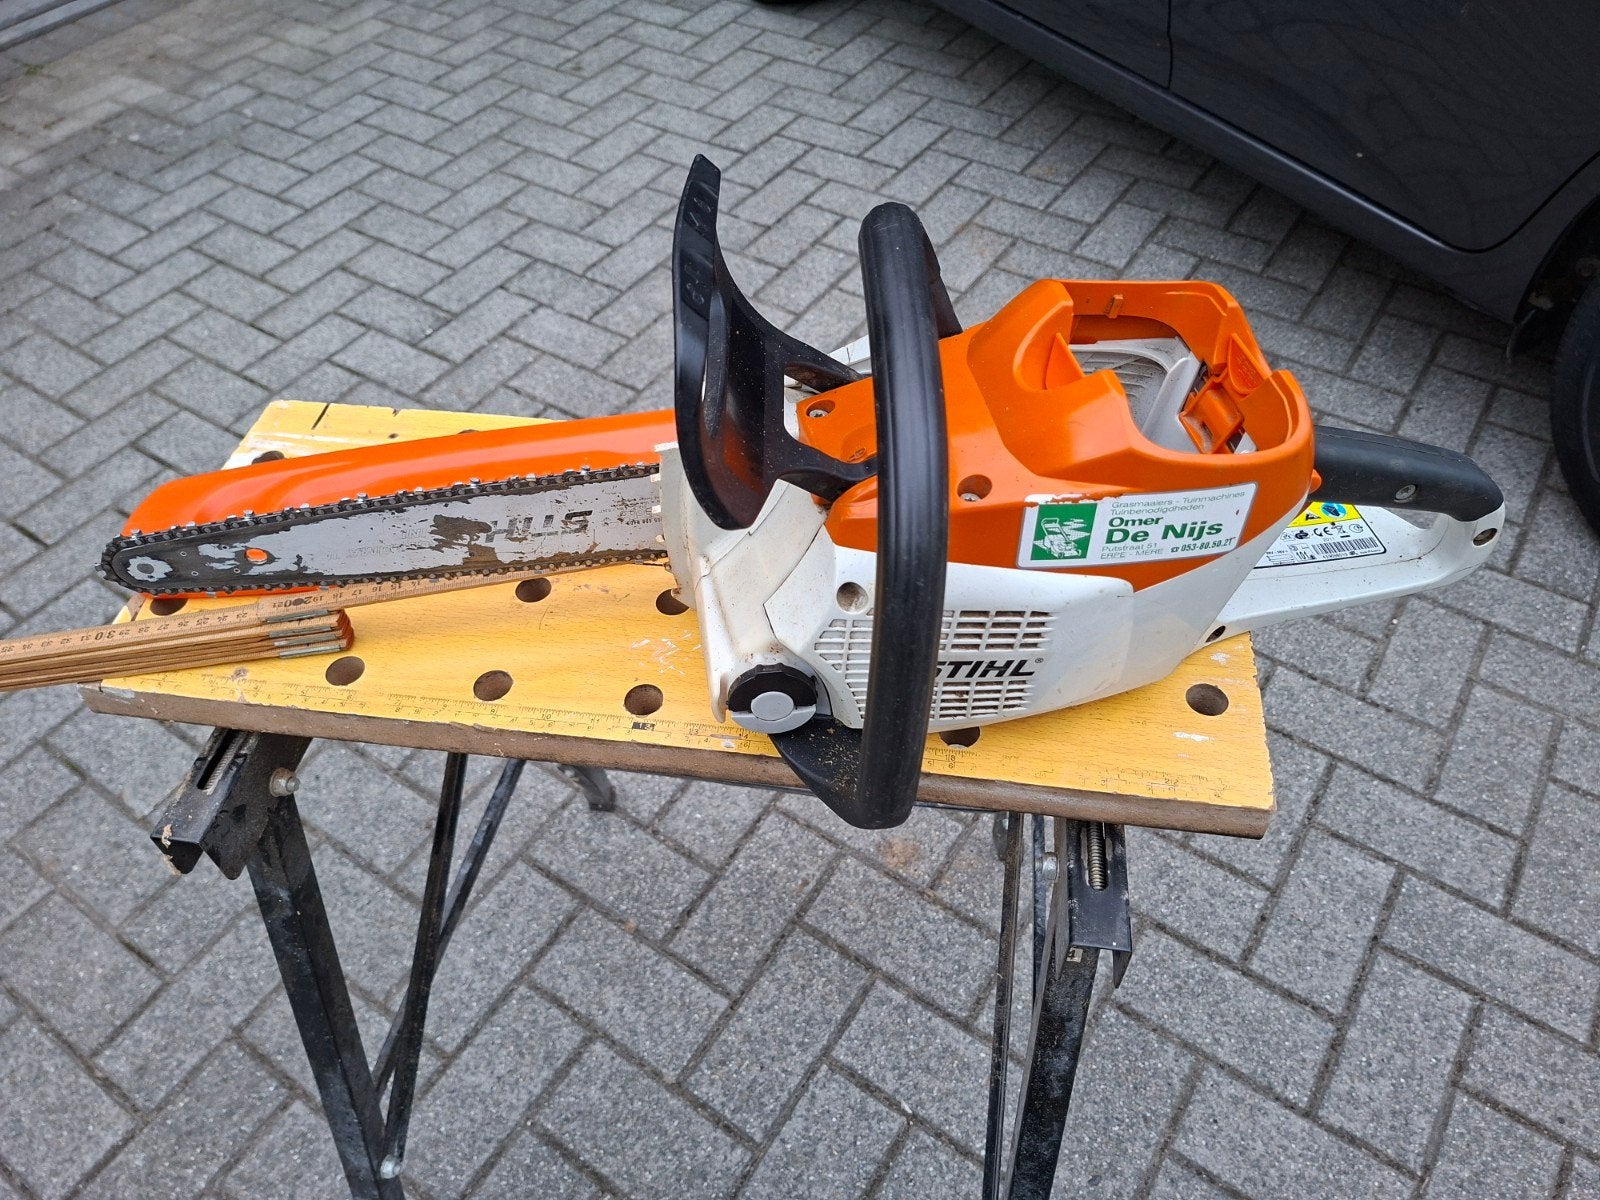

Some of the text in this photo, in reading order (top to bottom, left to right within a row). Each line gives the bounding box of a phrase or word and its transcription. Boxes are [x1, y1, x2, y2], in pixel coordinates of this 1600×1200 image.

[1111, 499, 1173, 509] Grasmaaiers
[1182, 491, 1246, 504] Tuinmachines
[1108, 516, 1164, 528] Omer
[1105, 520, 1223, 545] De Nijs
[1100, 551, 1127, 560] ERPE
[1135, 548, 1164, 557] MERE
[1101, 543, 1145, 553] Putstraat
[157, 623, 170, 631] 27
